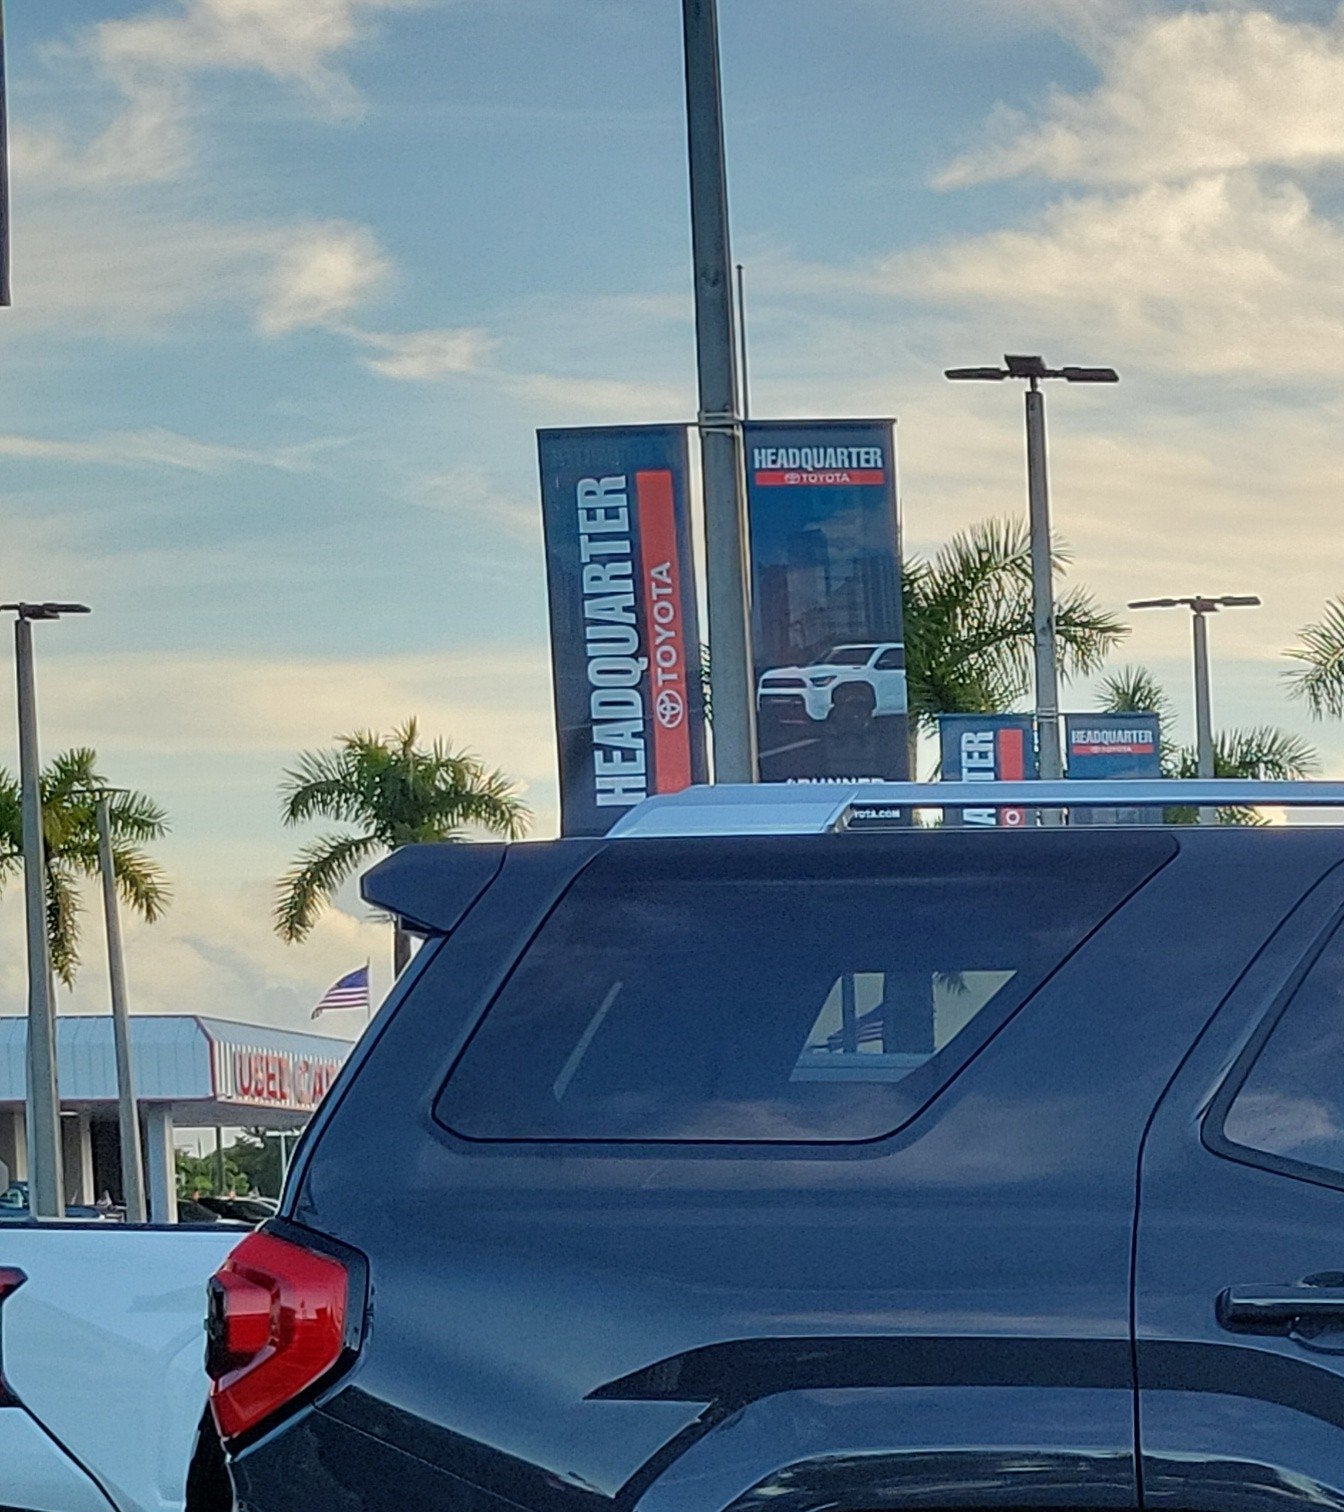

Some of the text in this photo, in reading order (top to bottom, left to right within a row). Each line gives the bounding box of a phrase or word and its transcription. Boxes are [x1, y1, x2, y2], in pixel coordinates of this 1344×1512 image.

[754, 447, 883, 471] HEADQUARTER
[801, 473, 850, 484] TOYOTA
[650, 562, 679, 687] TOYOTA
[576, 474, 648, 807] HEADQUARTER
[1072, 730, 1153, 744] HEADQUARTER
[854, 810, 900, 818] YOTA.COM
